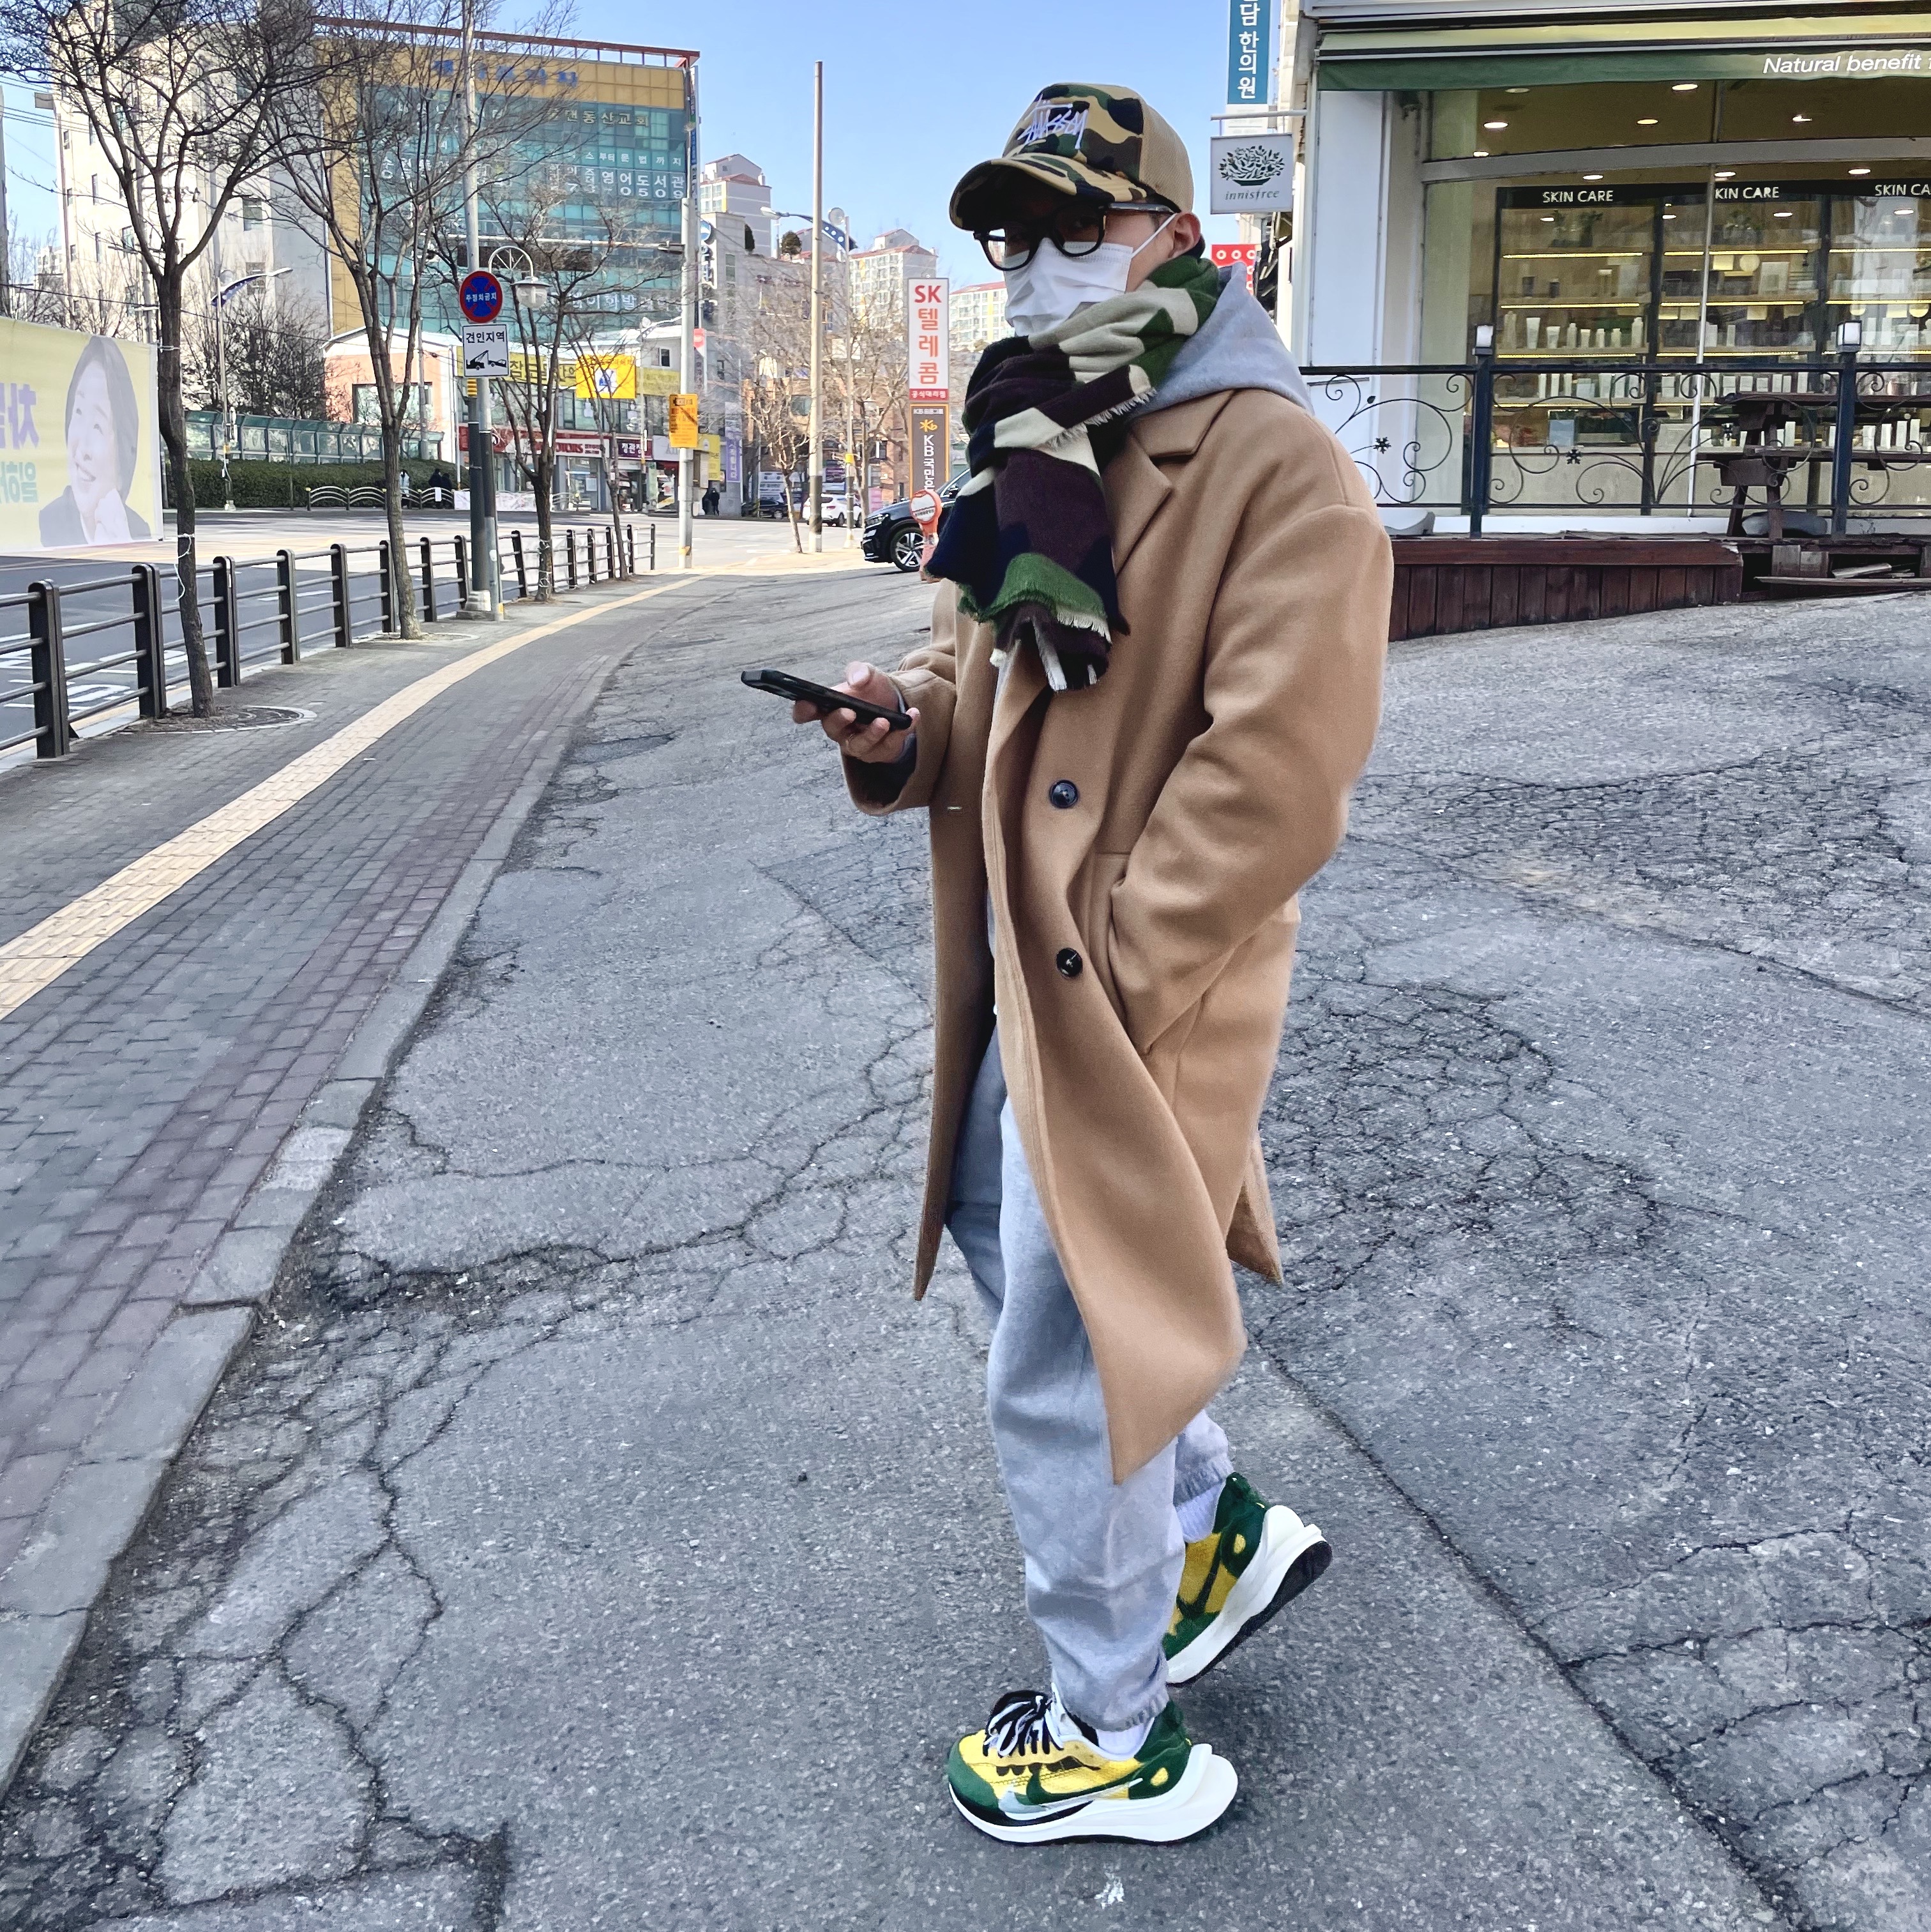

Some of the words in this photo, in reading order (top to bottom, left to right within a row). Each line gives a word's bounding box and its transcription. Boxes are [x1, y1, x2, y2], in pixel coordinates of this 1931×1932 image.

[1239, 0, 1261, 26] 담
[1238, 31, 1260, 100] 한의원
[1762, 55, 1842, 74] Natural
[1846, 52, 1922, 72] benefit
[601, 171, 685, 189] 영어도서관
[1225, 188, 1280, 201] innisfree
[1542, 191, 1573, 203] SKIN
[1577, 190, 1614, 203] CARE
[1715, 187, 1739, 200] KIN
[1743, 186, 1780, 199] CARE
[1874, 183, 1907, 197] SKIN
[466, 291, 497, 303] 주정차금지
[914, 285, 942, 303] SK
[466, 331, 505, 344] 견인지역
[923, 434, 935, 491] KB국민은
